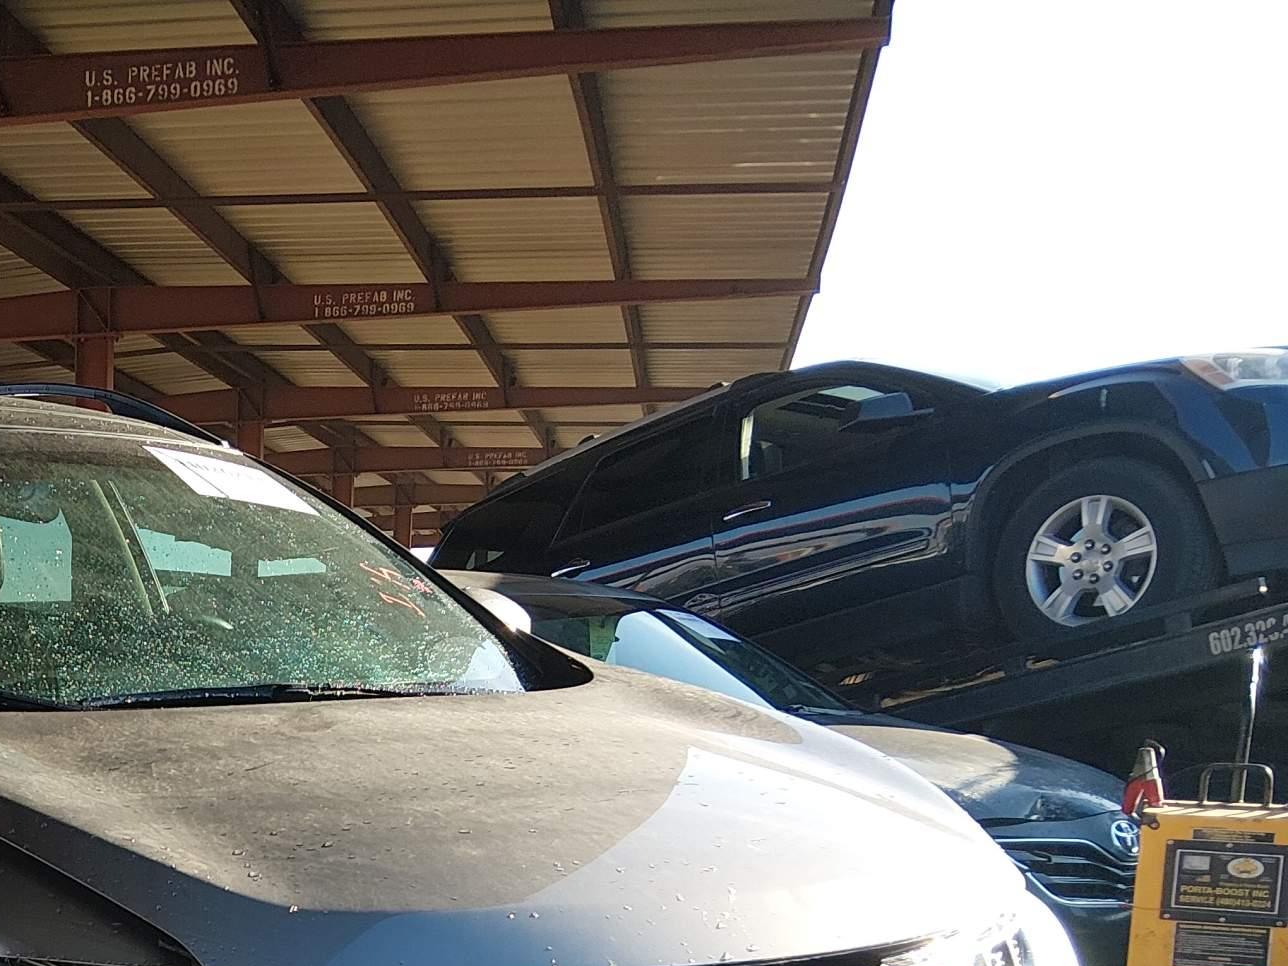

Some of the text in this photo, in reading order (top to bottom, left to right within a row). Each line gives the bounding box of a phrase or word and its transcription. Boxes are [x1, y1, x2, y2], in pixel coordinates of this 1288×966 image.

[85, 57, 240, 87] U.S. PREFAB INC.
[86, 78, 238, 107] 1-866-799-0969
[313, 289, 416, 306] U.S. PREFAB INC.
